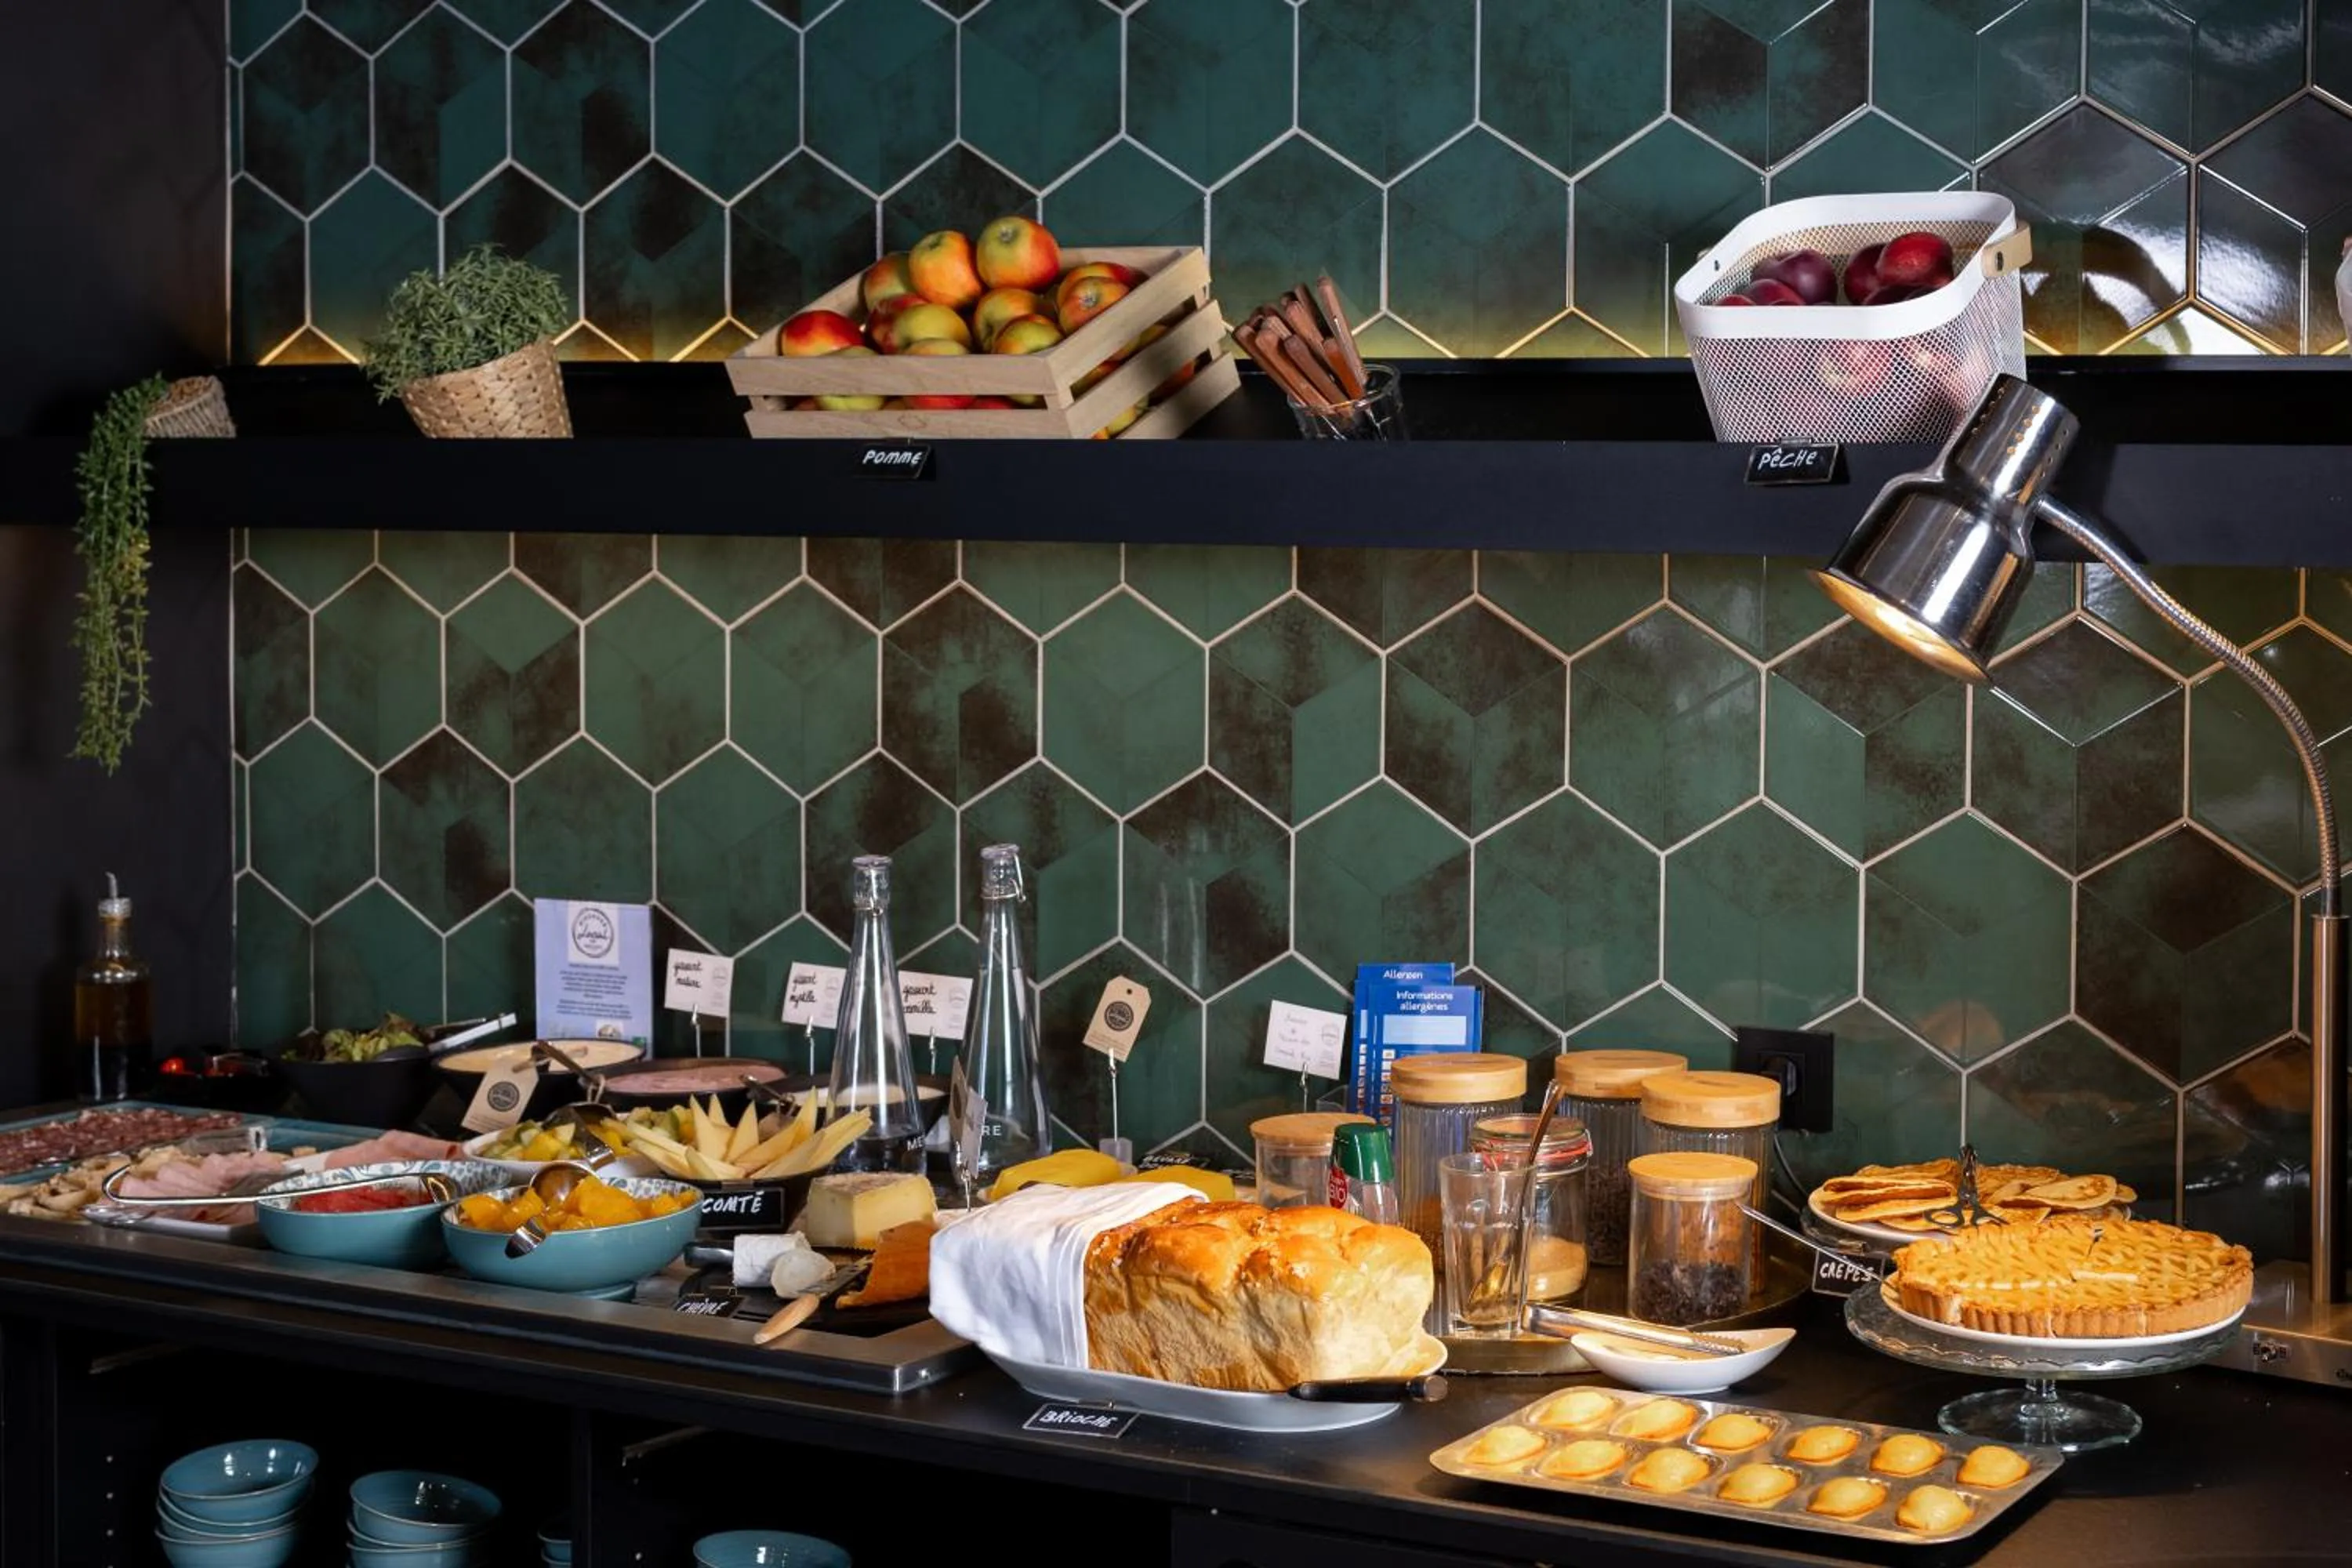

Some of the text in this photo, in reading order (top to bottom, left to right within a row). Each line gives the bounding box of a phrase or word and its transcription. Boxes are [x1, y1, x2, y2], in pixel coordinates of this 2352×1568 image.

[862, 449, 923, 465] POMME
[1396, 990, 1454, 1000] Informations
[702, 1190, 765, 1214] COMTÉ
